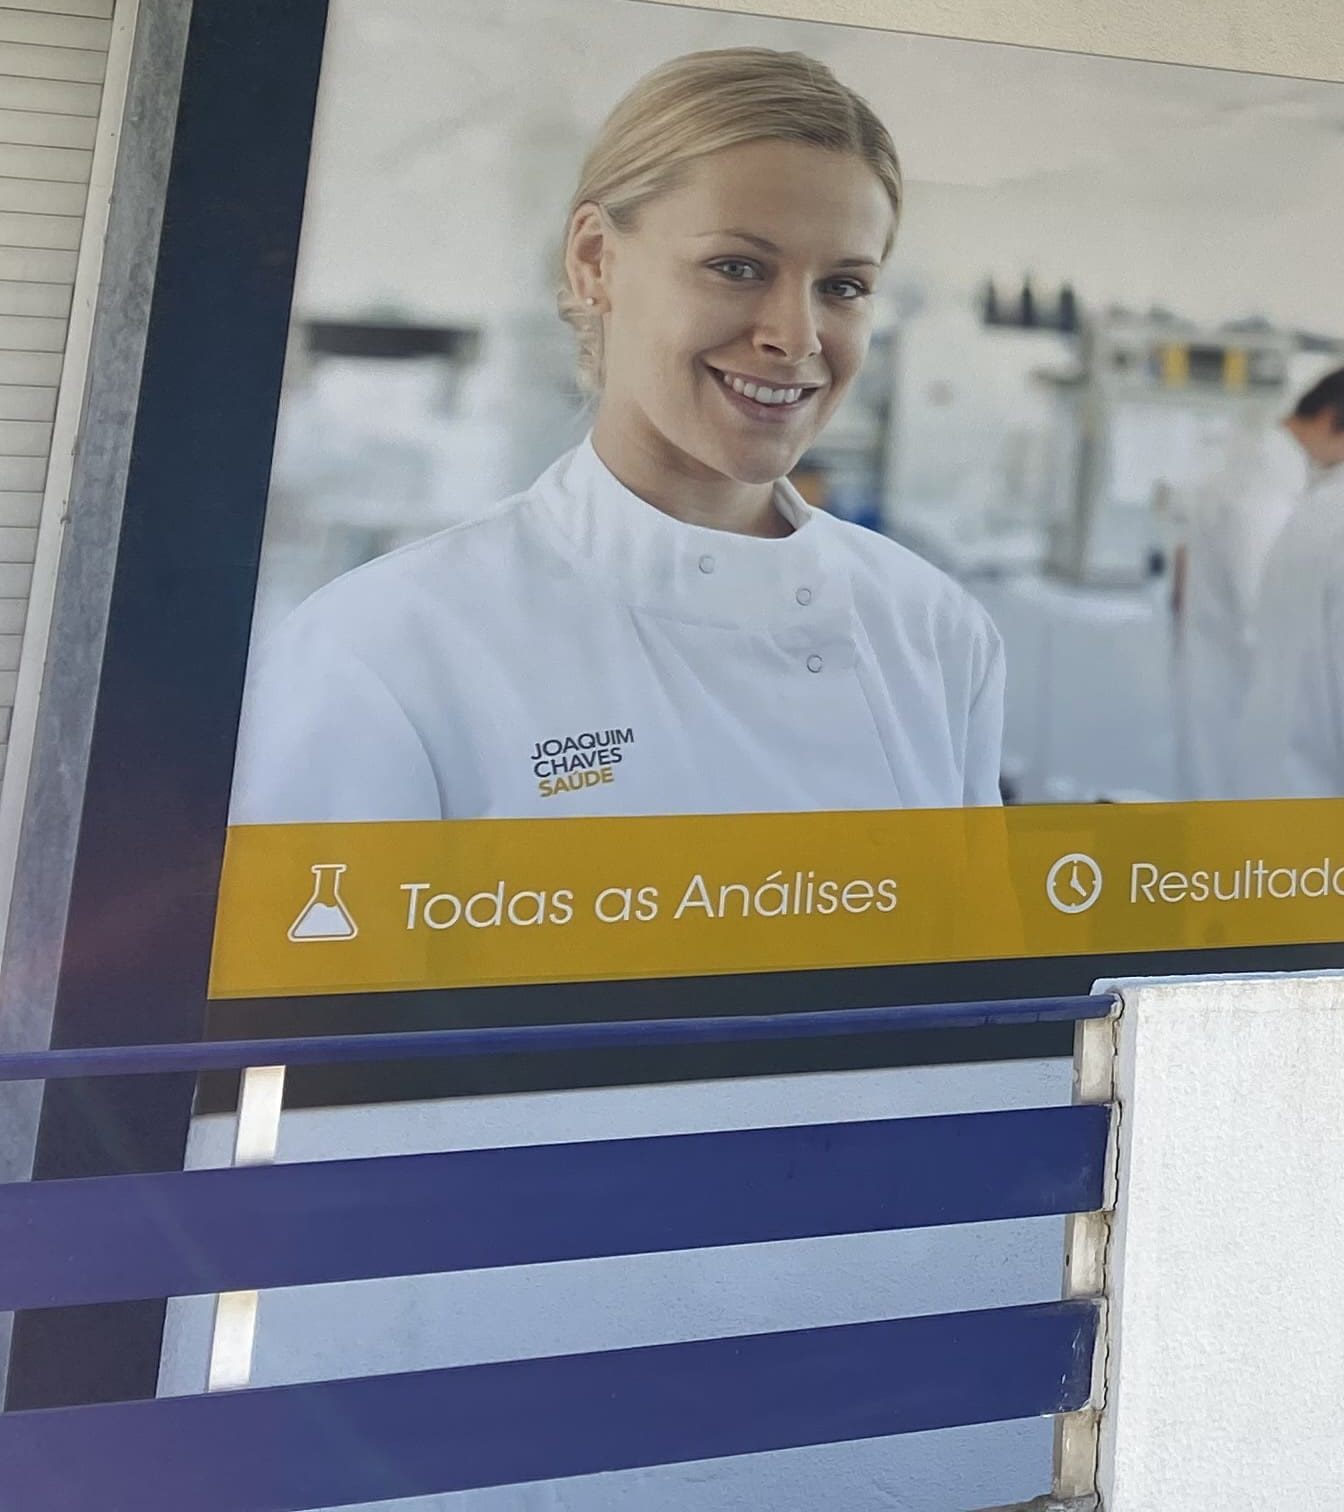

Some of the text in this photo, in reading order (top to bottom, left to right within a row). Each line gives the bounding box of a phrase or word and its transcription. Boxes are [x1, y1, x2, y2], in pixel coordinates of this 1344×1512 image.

[531, 728, 634, 760] JOAQUIM
[534, 747, 622, 778] CHAVES
[538, 767, 614, 797] SAÚDE
[399, 870, 898, 930] Todas as Análises
